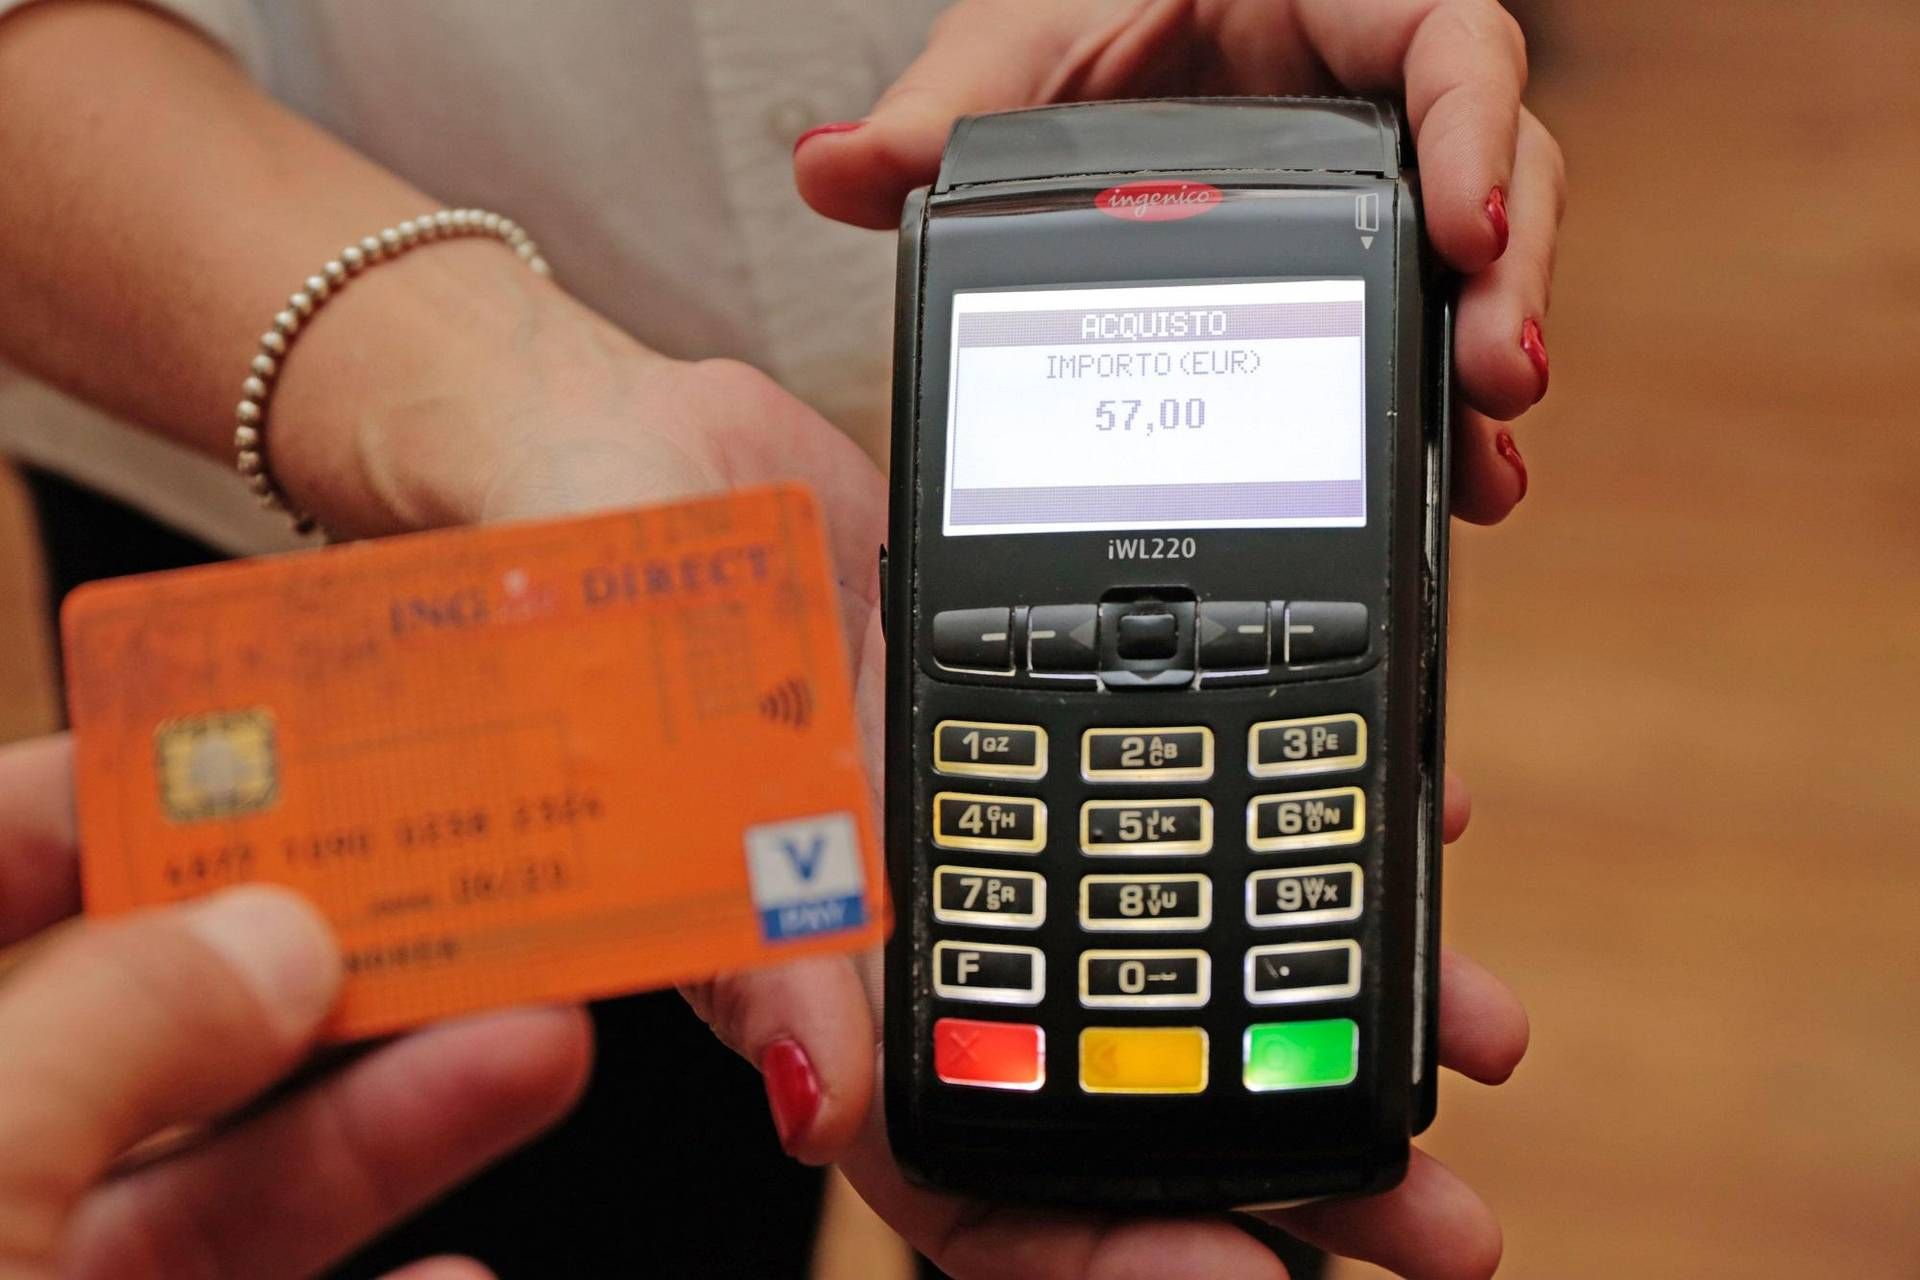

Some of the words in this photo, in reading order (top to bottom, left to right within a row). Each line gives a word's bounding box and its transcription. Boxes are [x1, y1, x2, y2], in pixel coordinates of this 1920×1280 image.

[1107, 184, 1213, 218] ingenico
[1081, 310, 1228, 340] ACQUISTO
[1095, 398, 1206, 436] 57,00
[1107, 537, 1197, 560] iWL220
[582, 544, 775, 607] DIRECT
[777, 835, 827, 881] V
[957, 952, 980, 985] F
